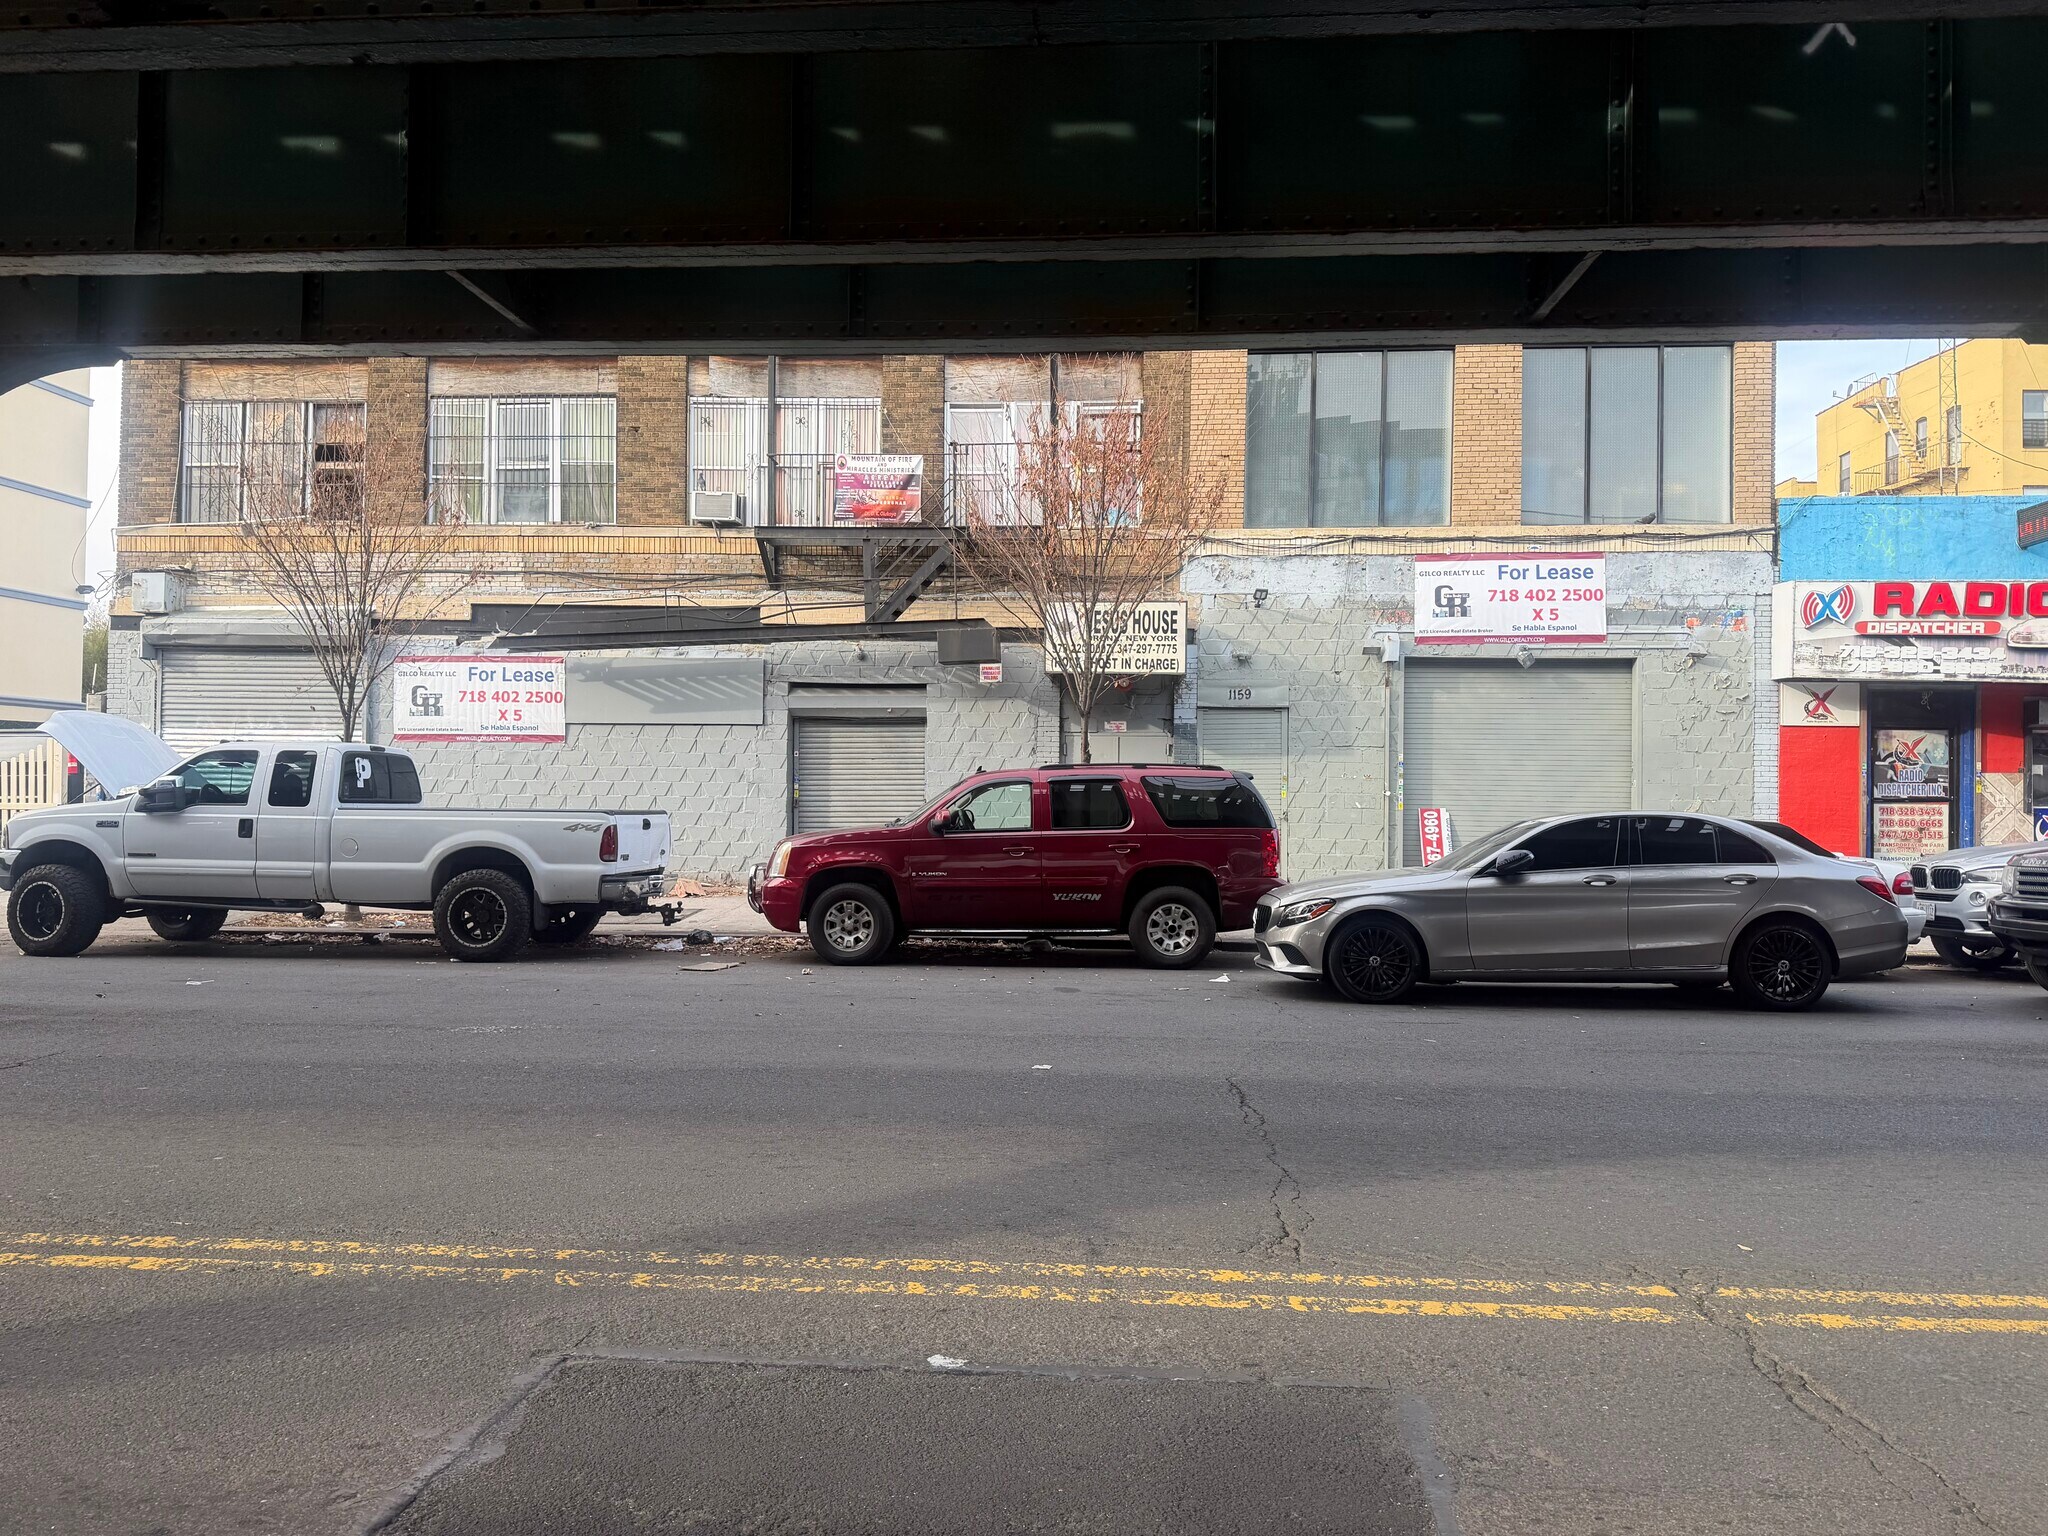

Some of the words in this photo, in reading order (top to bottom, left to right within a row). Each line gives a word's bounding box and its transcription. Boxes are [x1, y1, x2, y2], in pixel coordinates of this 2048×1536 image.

[1498, 564, 1529, 580] For
[1536, 564, 1594, 580] Lease
[1488, 589, 1519, 602] 718
[1525, 588, 1556, 601] 402
[1562, 588, 1604, 601] 2500
[1532, 608, 1544, 621] X
[1549, 608, 1559, 621] 5
[1087, 610, 1128, 634] ESUS
[1132, 610, 1178, 634] HOUSE
[1511, 624, 1522, 632] Se
[1547, 624, 1578, 632] Espanol
[1867, 621, 1985, 634] DISPATCHER
[1121, 658, 1132, 669] IN
[1134, 658, 1180, 673] CHARGE)
[468, 667, 497, 682] For
[502, 667, 555, 682] Lease
[458, 690, 487, 703] 718
[491, 690, 521, 703] 402
[525, 691, 564, 704] 2500
[1228, 688, 1252, 701] 1159
[498, 709, 509, 721] X
[513, 709, 523, 721] 5
[512, 724, 539, 732] Espanol
[1899, 770, 1924, 782] RADIO
[1878, 784, 1927, 796] DISPATCHER
[1928, 784, 1945, 796] INC.
[1052, 893, 1102, 901] YUKON
